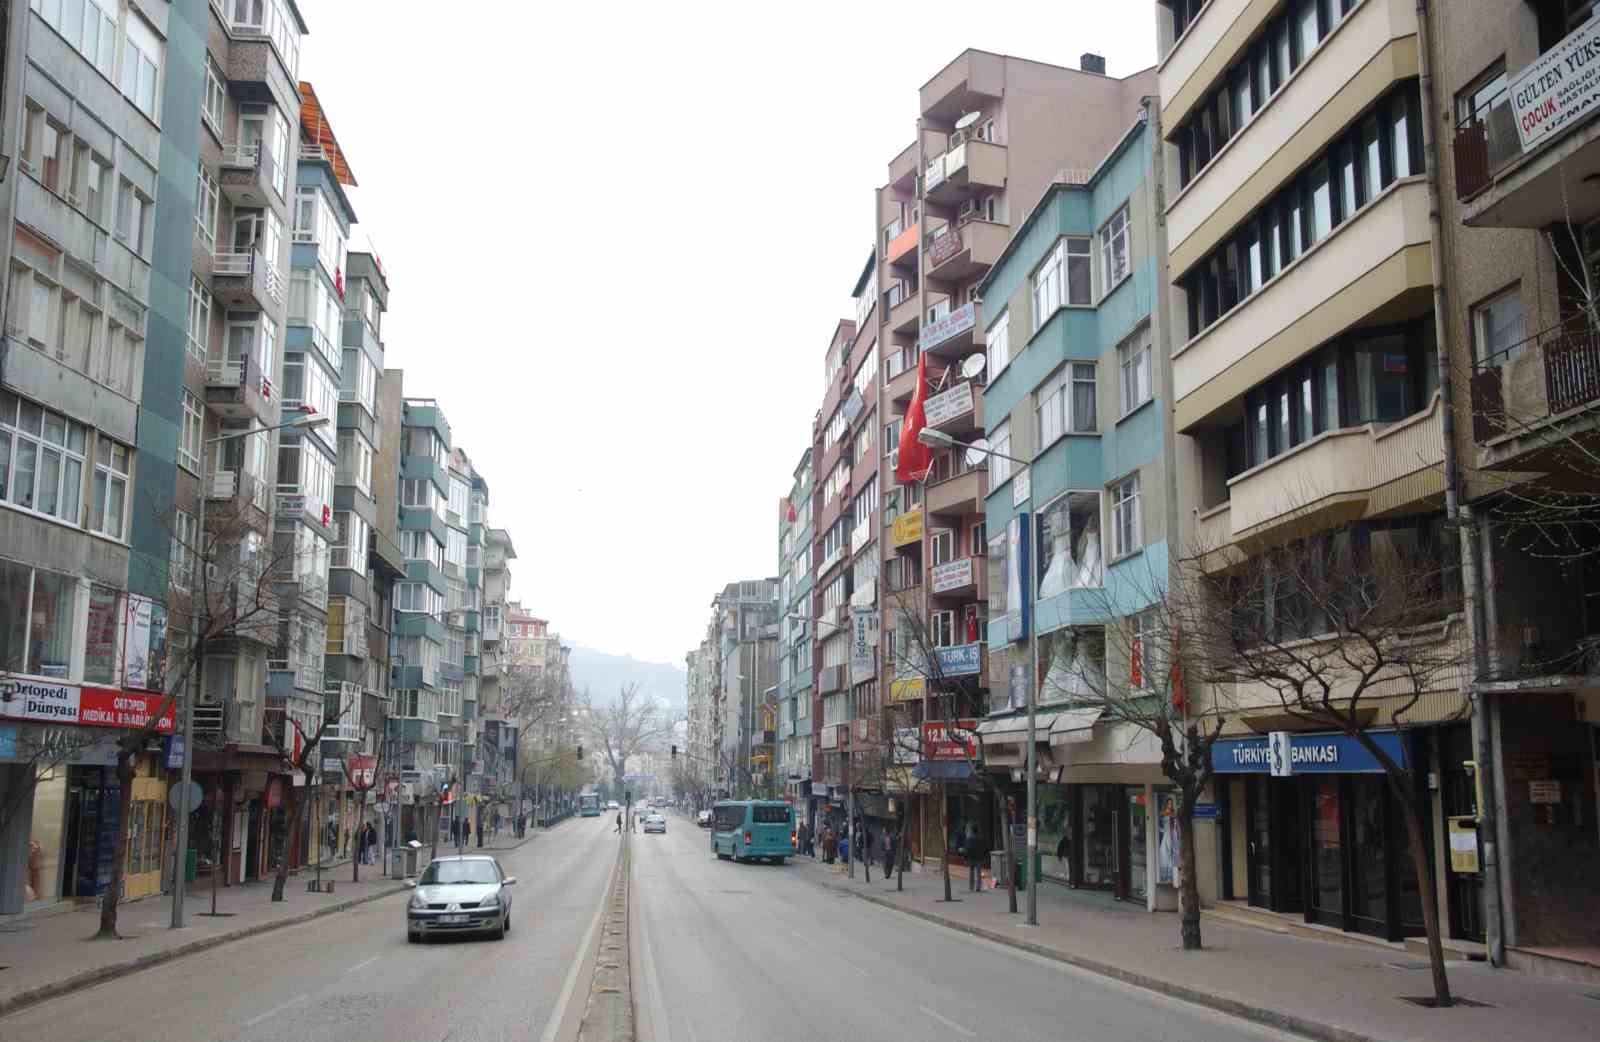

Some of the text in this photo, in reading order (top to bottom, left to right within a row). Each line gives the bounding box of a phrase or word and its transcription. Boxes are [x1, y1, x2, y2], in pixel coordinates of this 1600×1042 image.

[1521, 96, 1557, 135] ÇOCUK
[28, 700, 77, 717] Dünyası
[82, 707, 115, 723] MEDİKAL
[1232, 743, 1271, 763] TÜRKİYE
[1291, 744, 1338, 762] BANKASI
